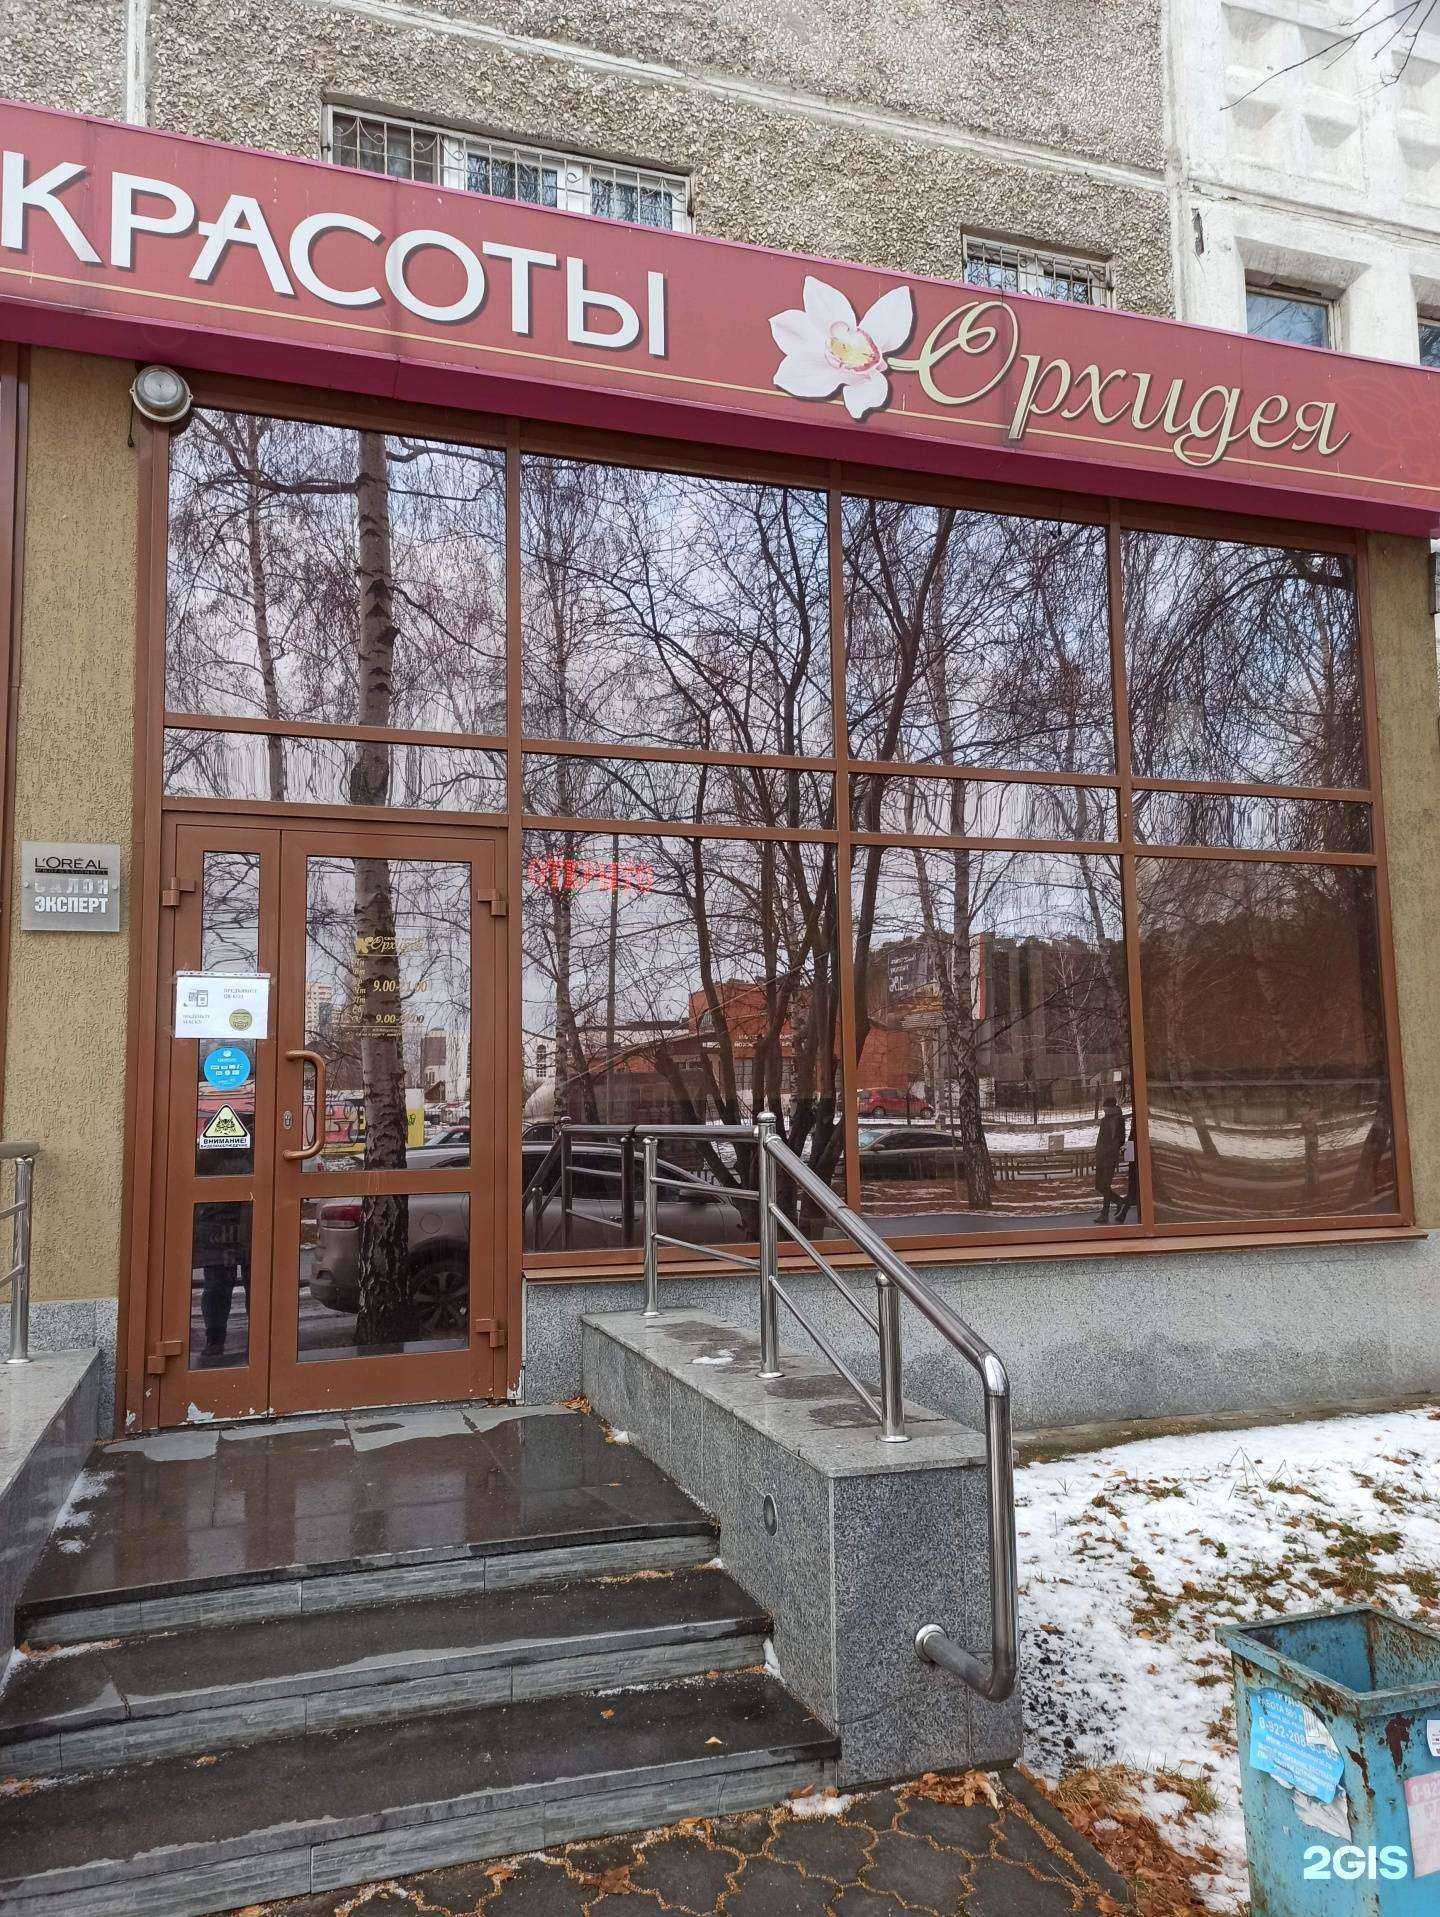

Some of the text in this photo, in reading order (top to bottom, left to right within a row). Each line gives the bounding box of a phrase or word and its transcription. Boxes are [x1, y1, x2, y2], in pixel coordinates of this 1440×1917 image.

[1, 150, 667, 357] КРАСОТЫ
[888, 301, 1350, 466] Орхидея
[34, 896, 109, 913] ЭКСПЕРТ
